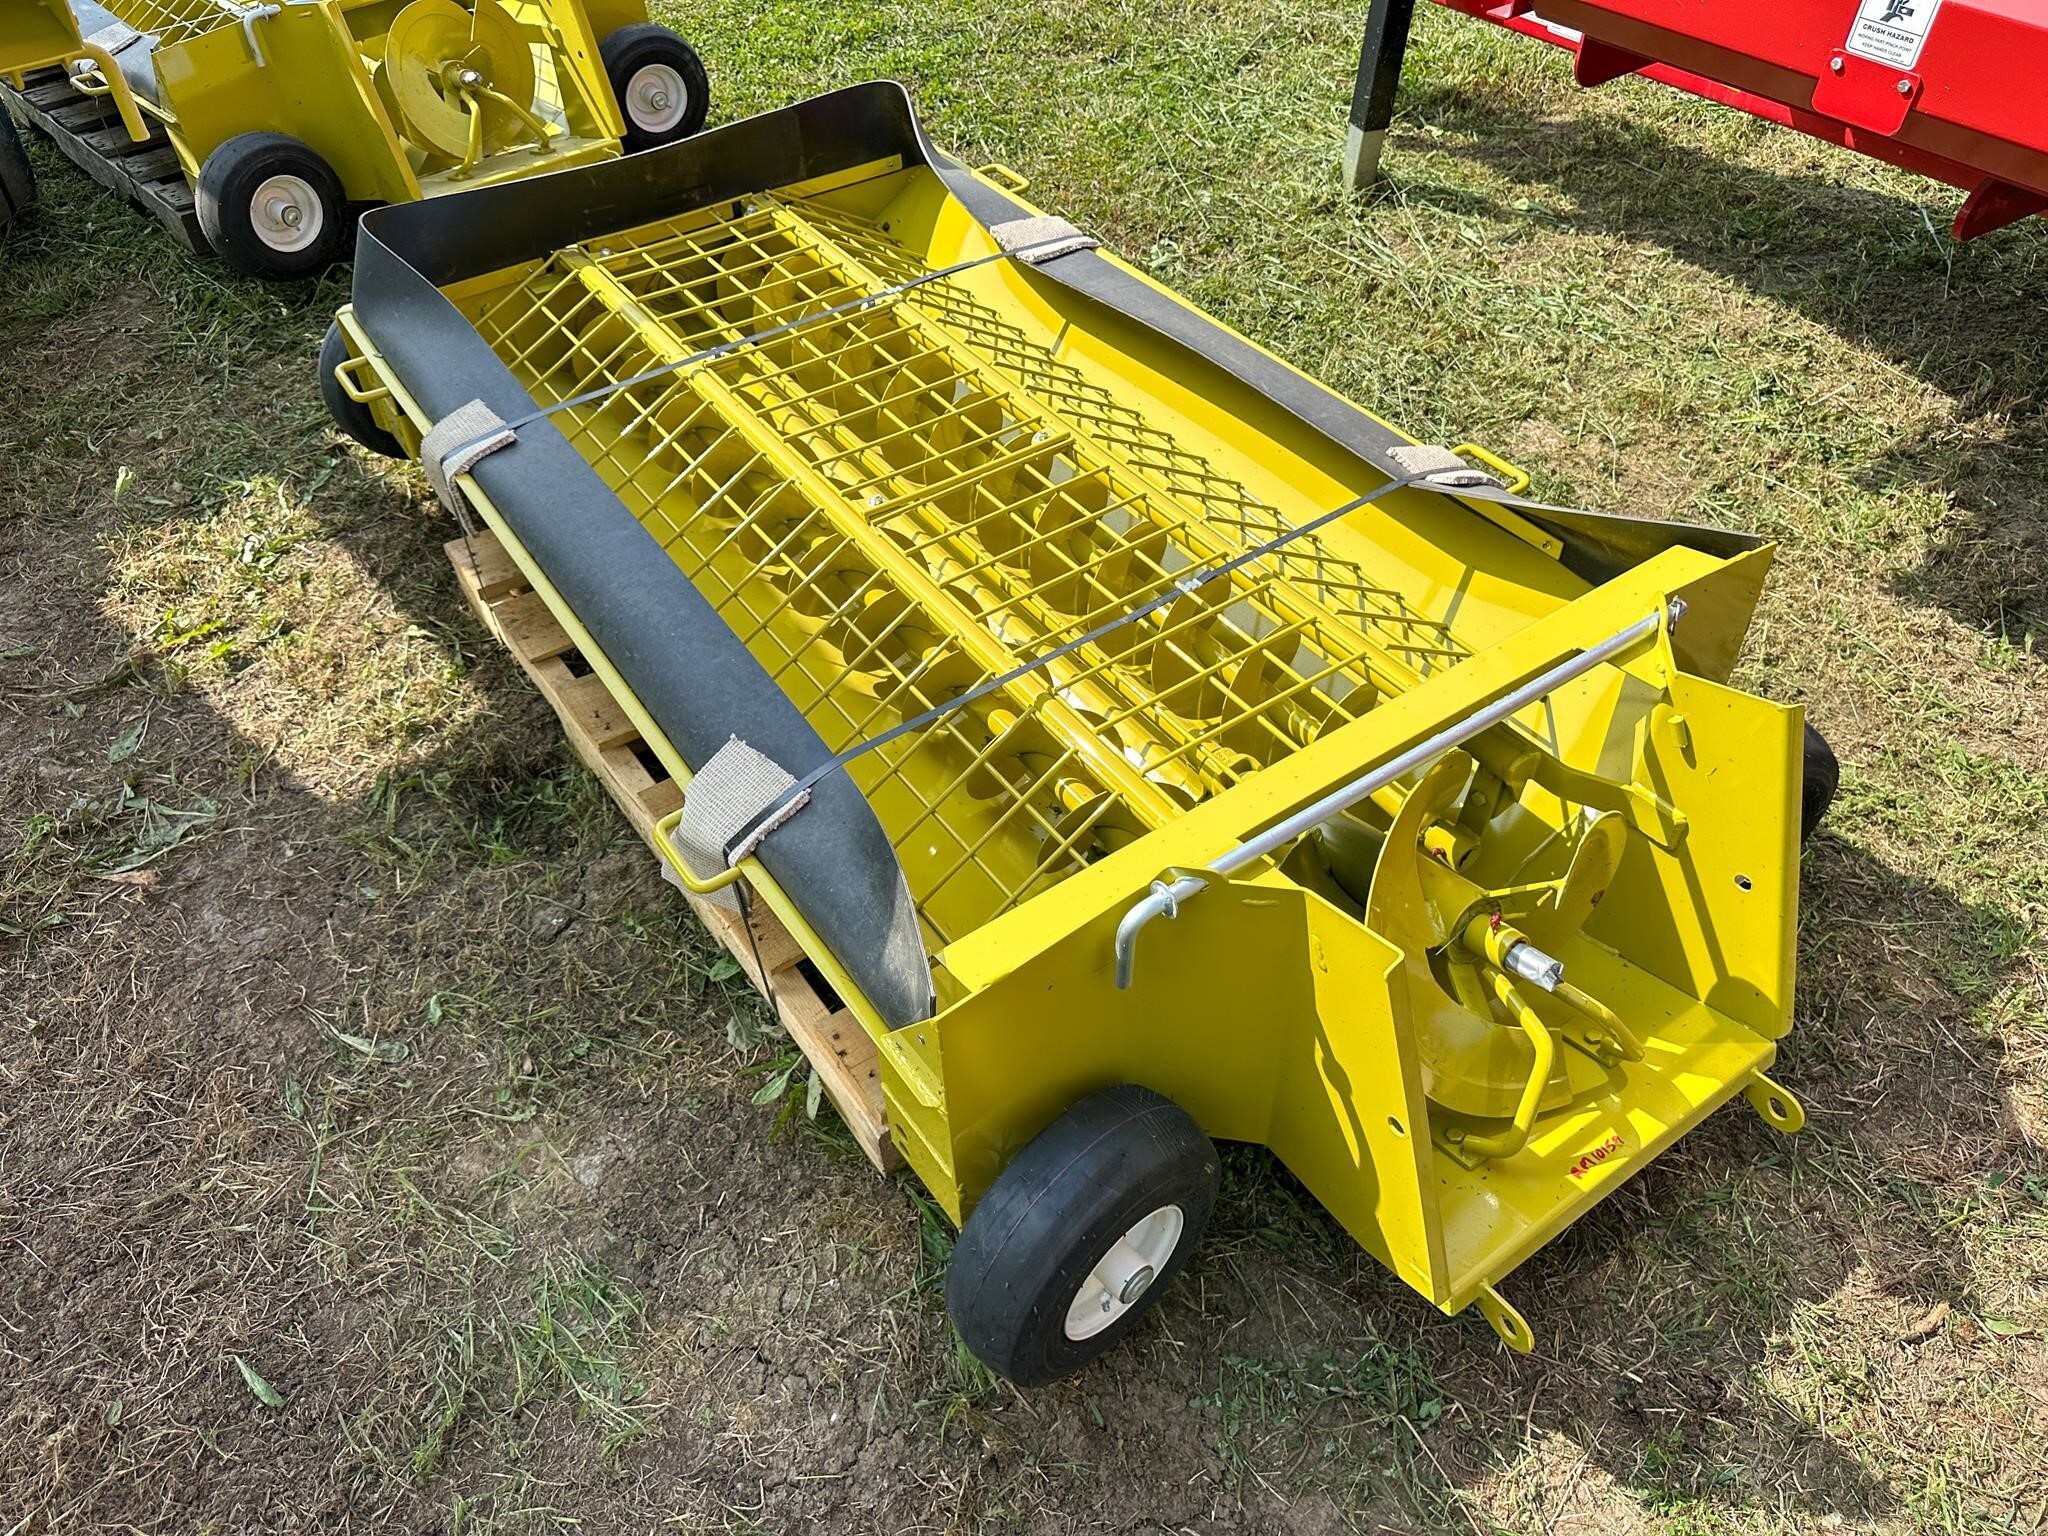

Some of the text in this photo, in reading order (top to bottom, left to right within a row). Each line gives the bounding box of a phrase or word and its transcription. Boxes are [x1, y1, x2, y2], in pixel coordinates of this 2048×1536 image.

[1862, 23, 1914, 44] CRUSH HAZARD
[1873, 45, 1887, 54] HANDS
[1888, 50, 1902, 58] CLEAR
